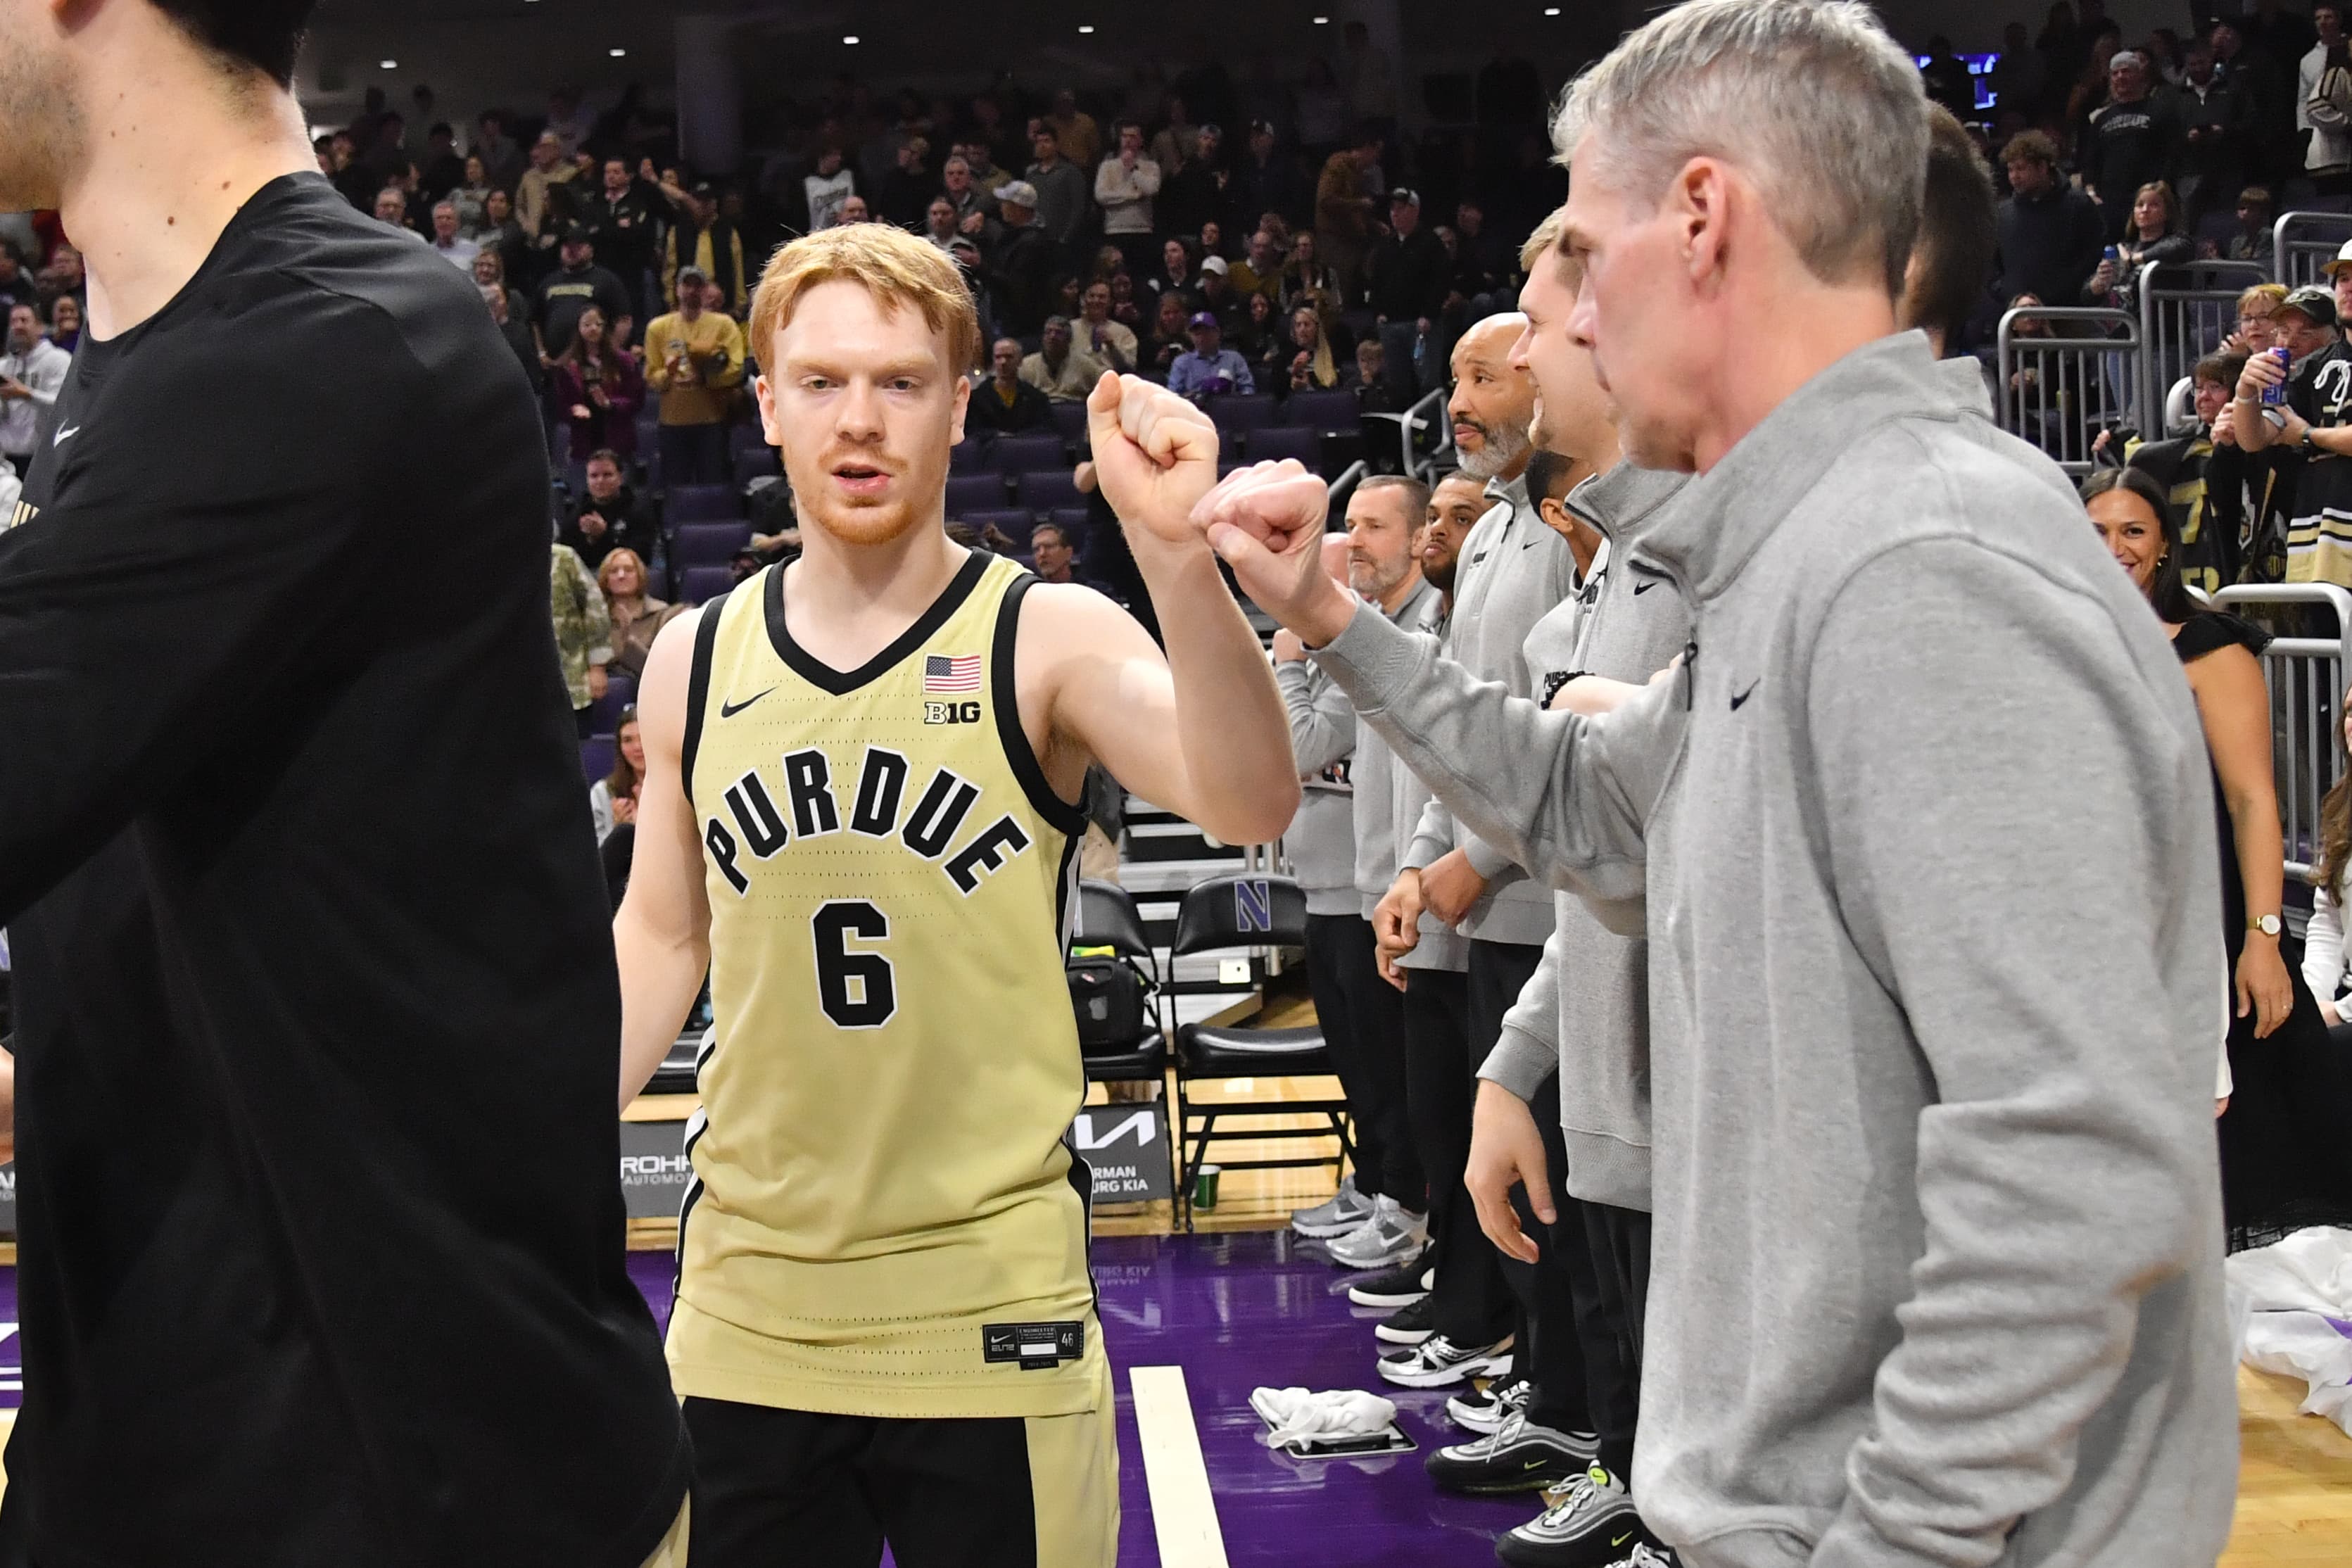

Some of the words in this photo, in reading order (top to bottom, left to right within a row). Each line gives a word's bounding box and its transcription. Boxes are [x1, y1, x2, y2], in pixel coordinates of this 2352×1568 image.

[705, 745, 1034, 898] PURDUE
[1234, 880, 1272, 932] N
[810, 898, 899, 1030] 6
[624, 1172, 692, 1186] AUTOMO
[1123, 1178, 1149, 1191] KIA
[1061, 1332, 1074, 1347] 46
